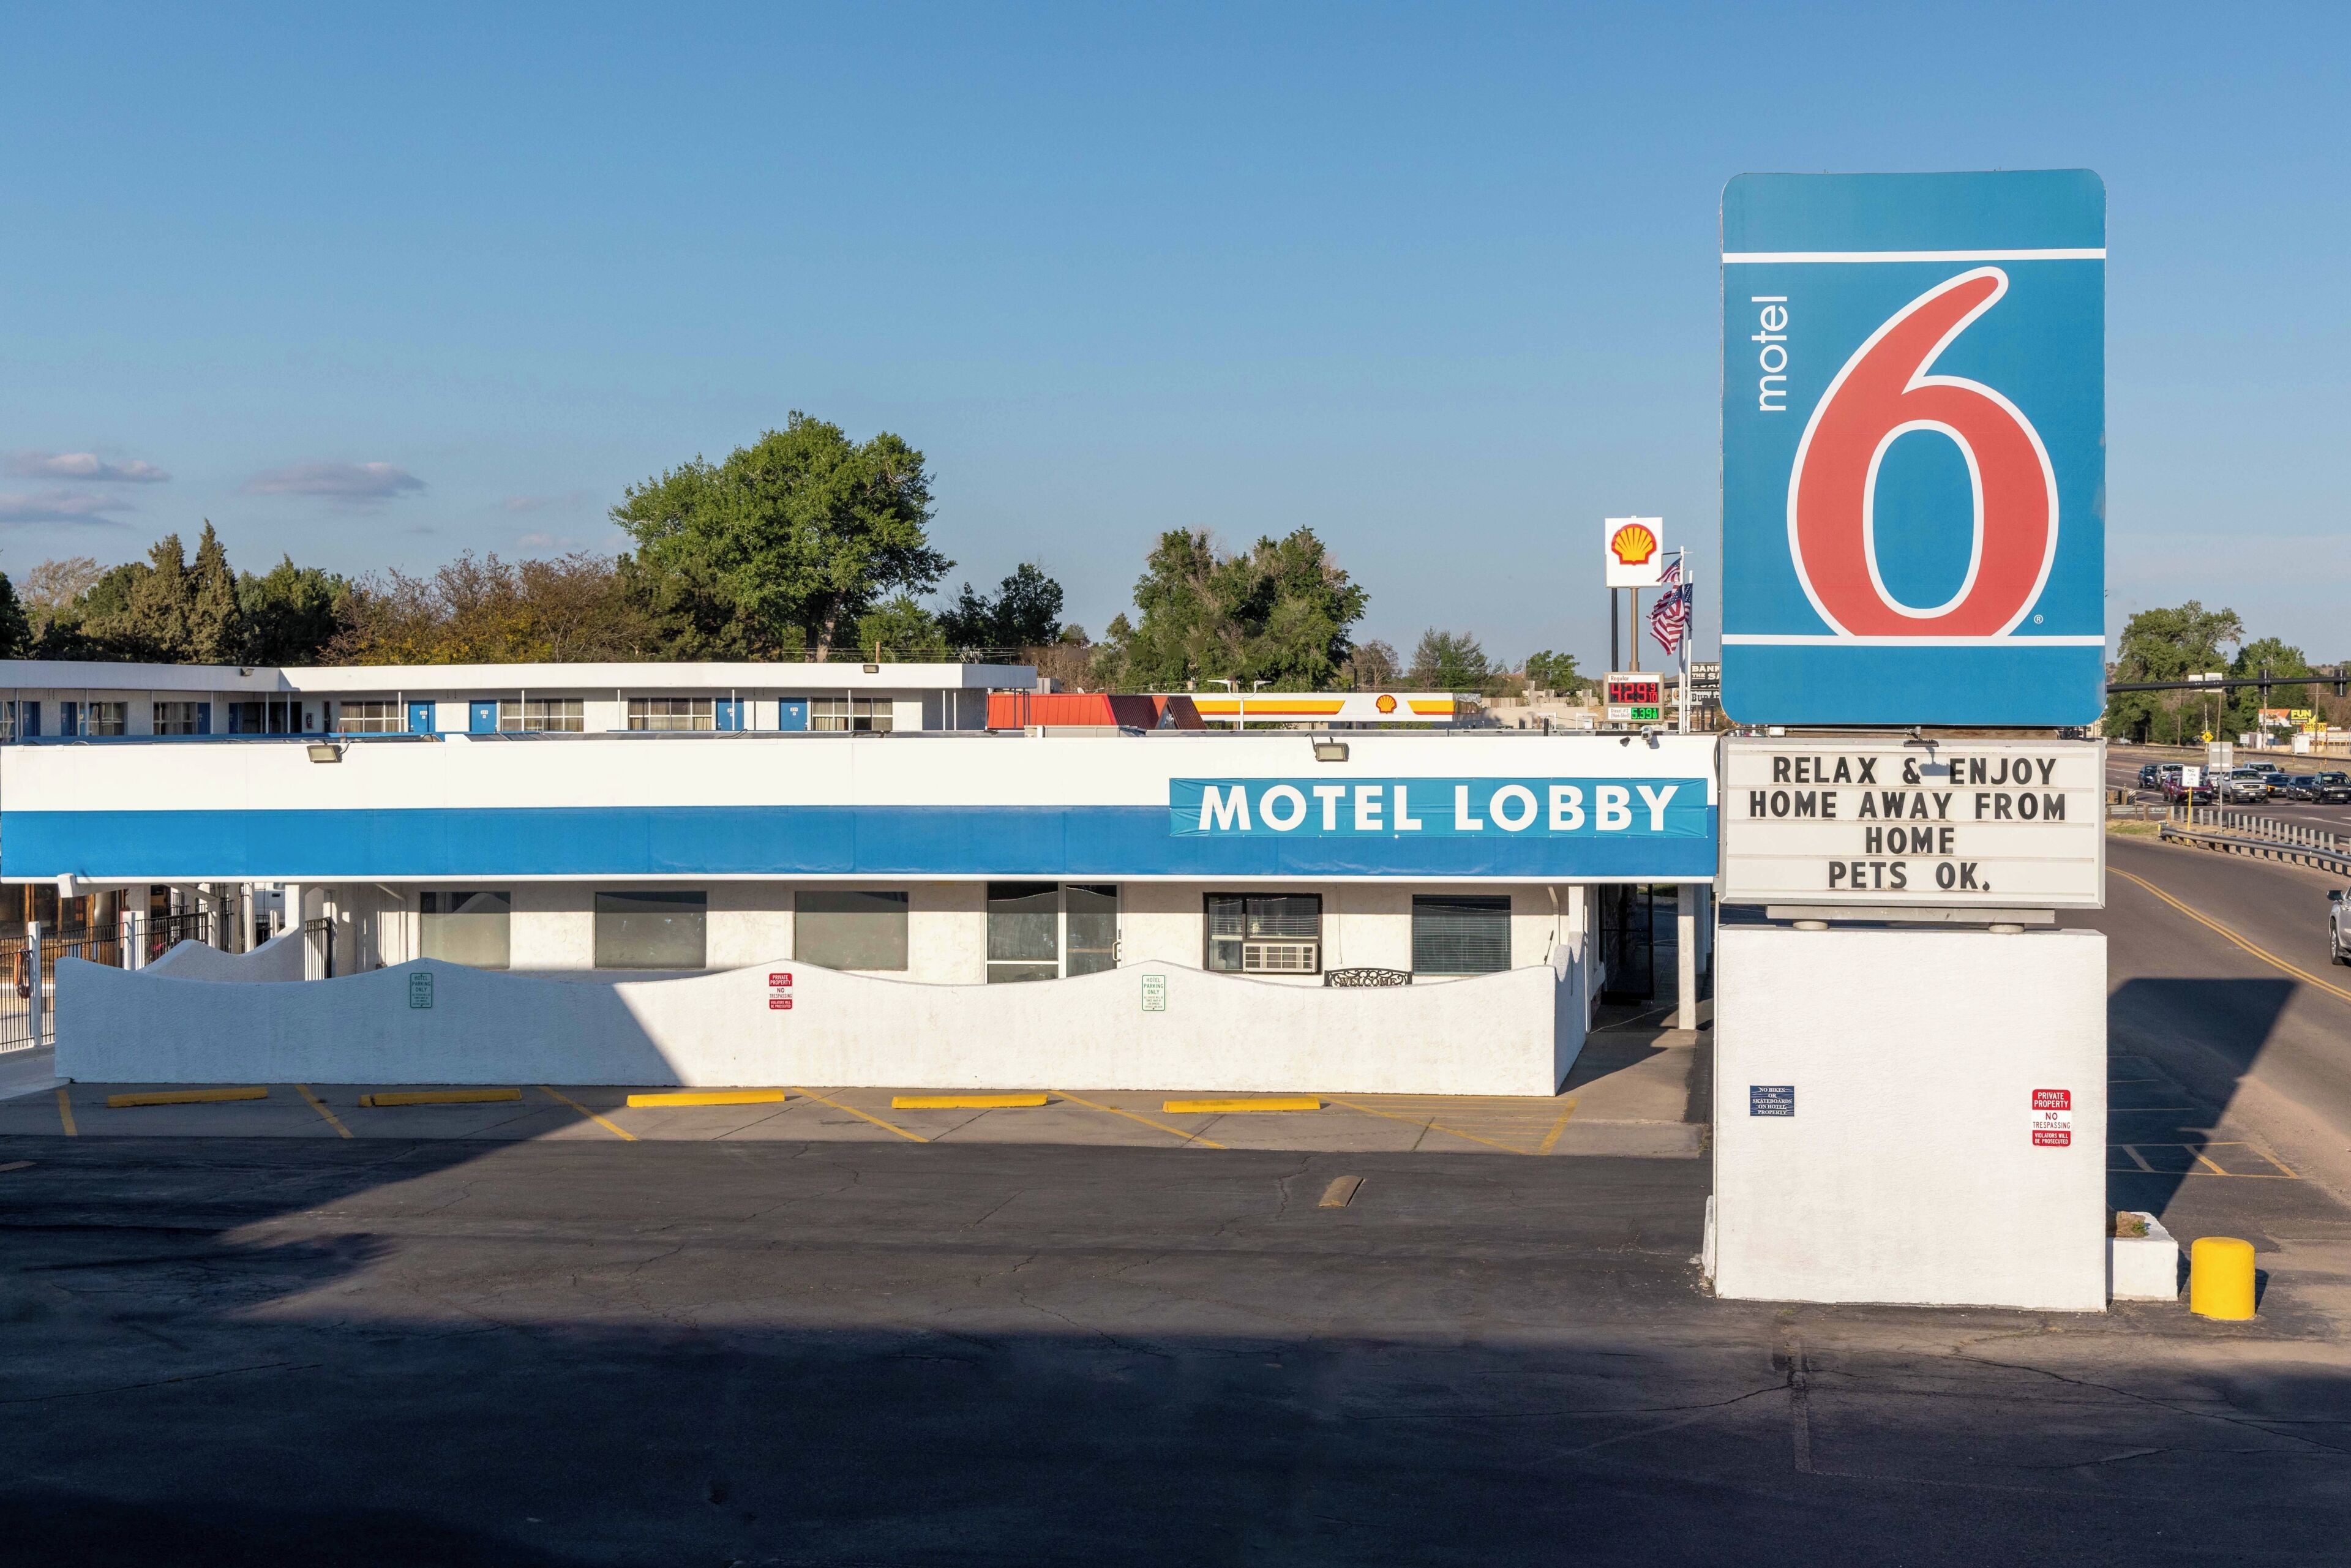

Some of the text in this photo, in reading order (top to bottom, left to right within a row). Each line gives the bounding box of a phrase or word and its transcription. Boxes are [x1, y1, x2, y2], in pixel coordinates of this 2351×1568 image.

[1752, 296, 1788, 411] motel
[1787, 266, 2059, 636] 6
[1774, 757, 2057, 785] RELAX & ENJOY
[1198, 784, 1679, 831] MOTEL LOBBY
[1750, 790, 2065, 820] HOME AWAY FROM
[1866, 827, 1954, 854] HOME
[1829, 861, 1907, 888] PETS
[1340, 977, 1397, 986] WELCOME
[2045, 1112, 2058, 1120] NO
